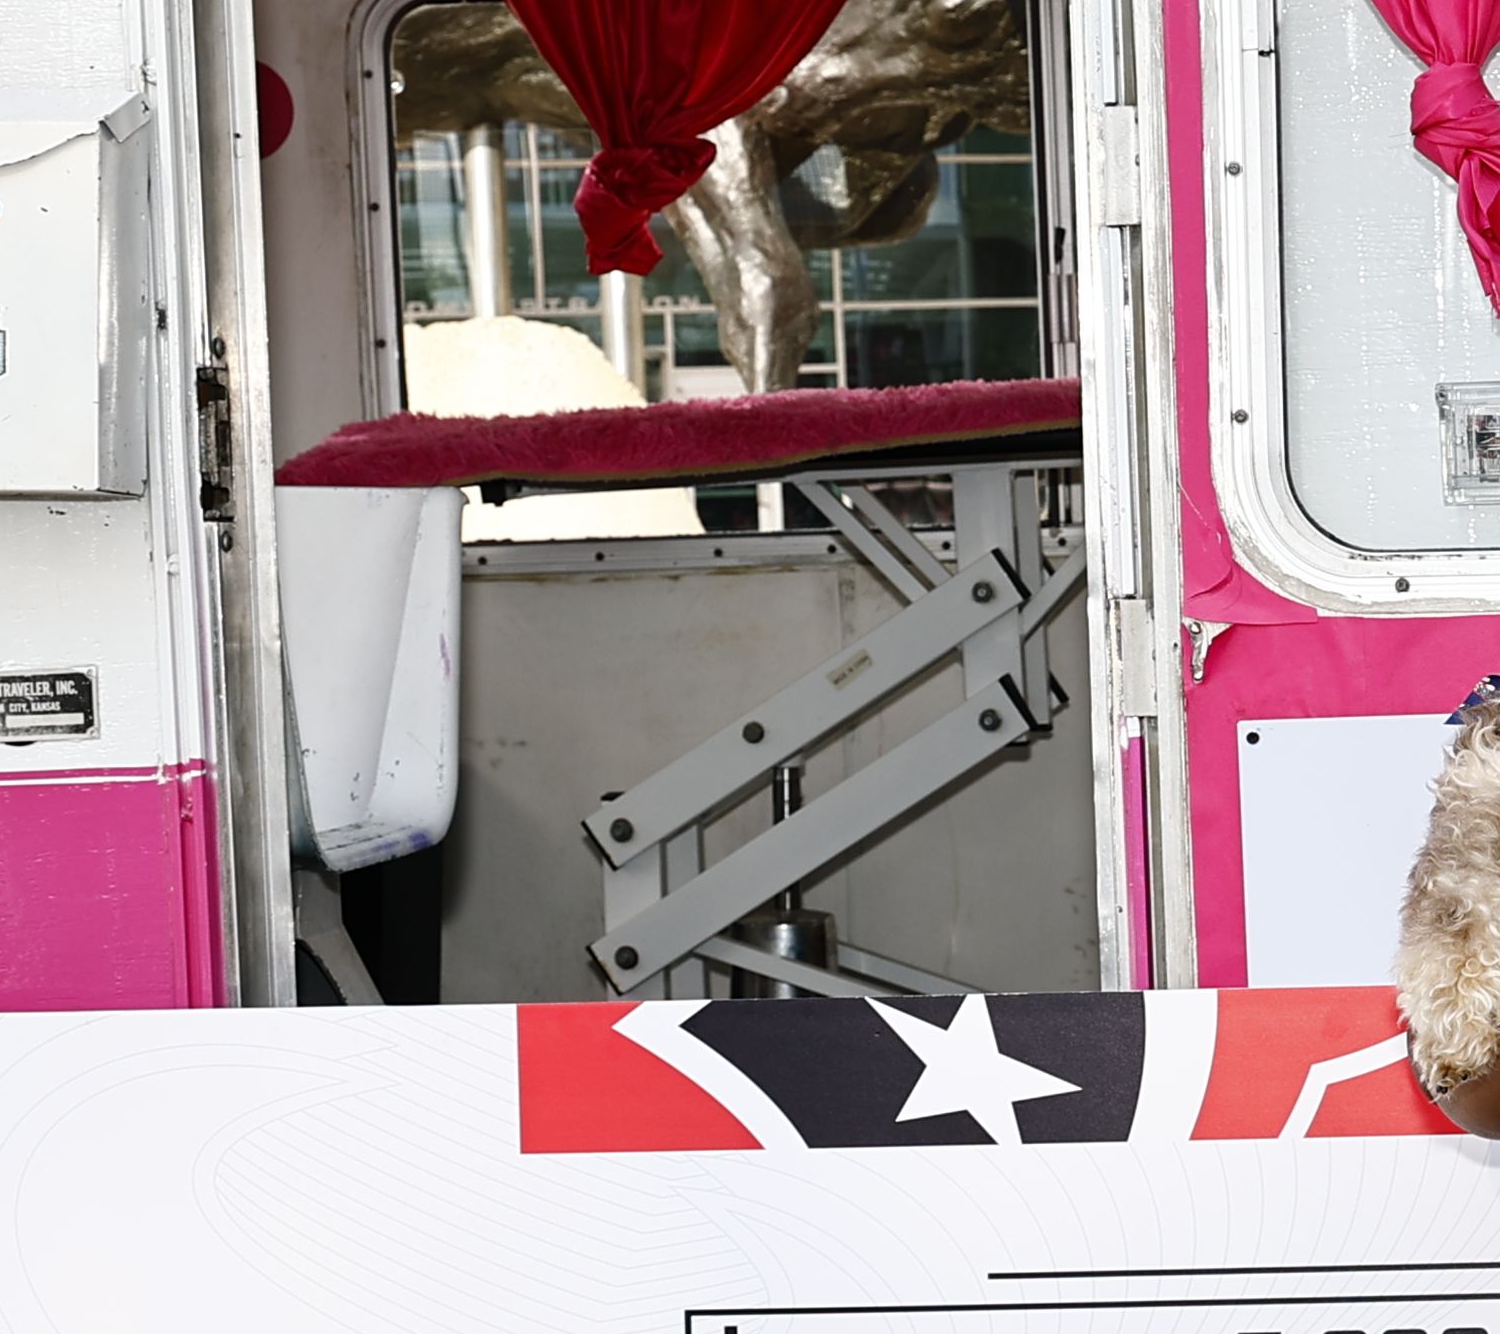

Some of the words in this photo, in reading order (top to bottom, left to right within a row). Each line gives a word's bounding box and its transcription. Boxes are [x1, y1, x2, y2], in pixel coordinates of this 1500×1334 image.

[55, 680, 78, 696] INC.
[8, 702, 30, 713] CITY,
[31, 701, 61, 712] KANSAS
